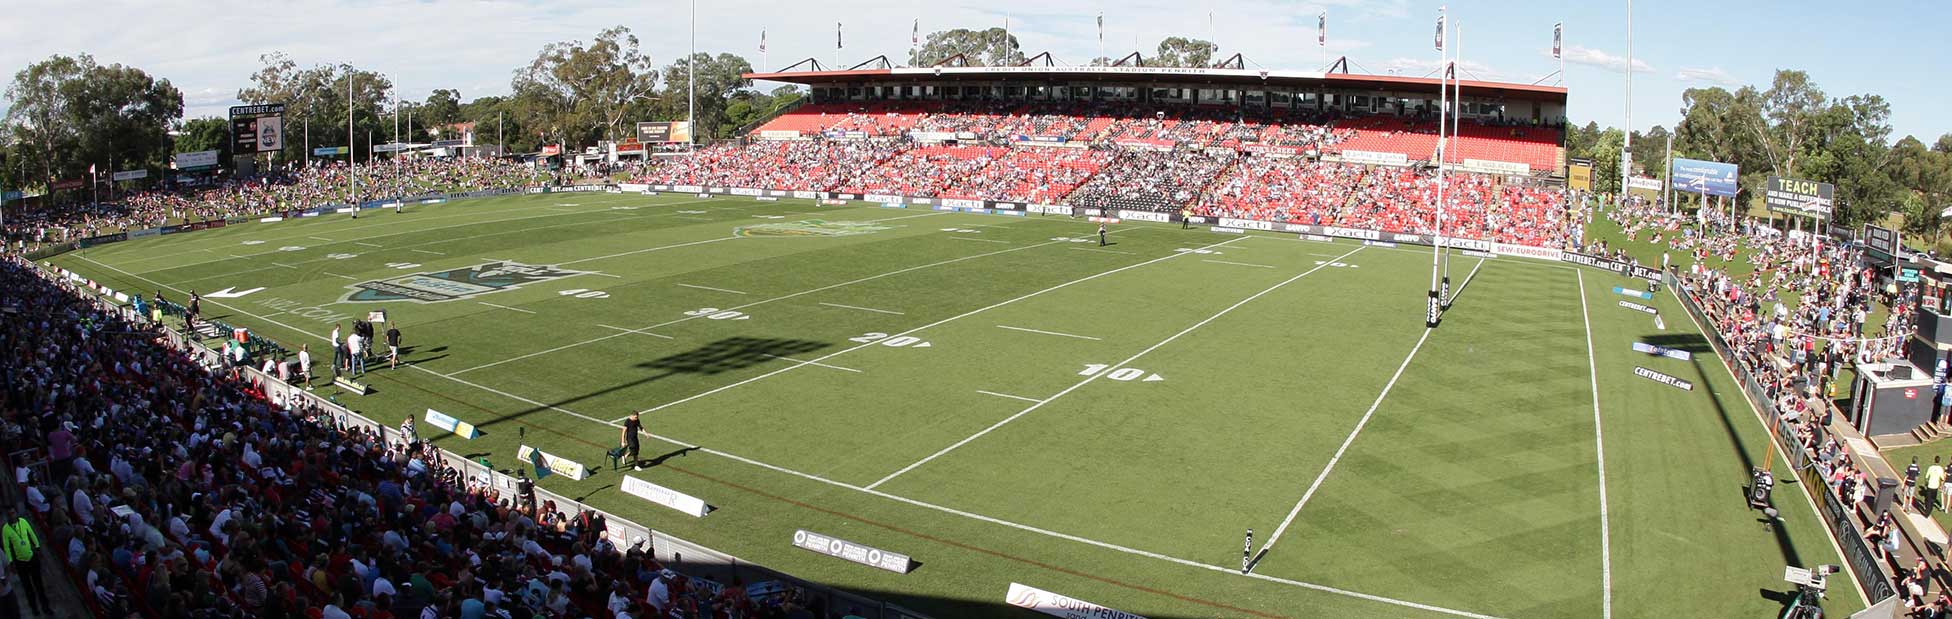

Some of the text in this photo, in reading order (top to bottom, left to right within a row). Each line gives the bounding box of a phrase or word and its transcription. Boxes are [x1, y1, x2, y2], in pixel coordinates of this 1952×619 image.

[232, 106, 284, 114] CENTREBET.com
[1779, 179, 1818, 195] TEACH
[1779, 191, 1793, 199] MAKE
[1224, 219, 1271, 230] Xacti
[1328, 228, 1376, 239] Xacti
[1562, 252, 1609, 269] CENTREBET.com
[684, 307, 743, 320] 30
[848, 332, 921, 347] 20
[1078, 364, 1144, 380] 10
[1634, 367, 1692, 391] CENTREBET.com
[1051, 595, 1091, 614] SOUTH
